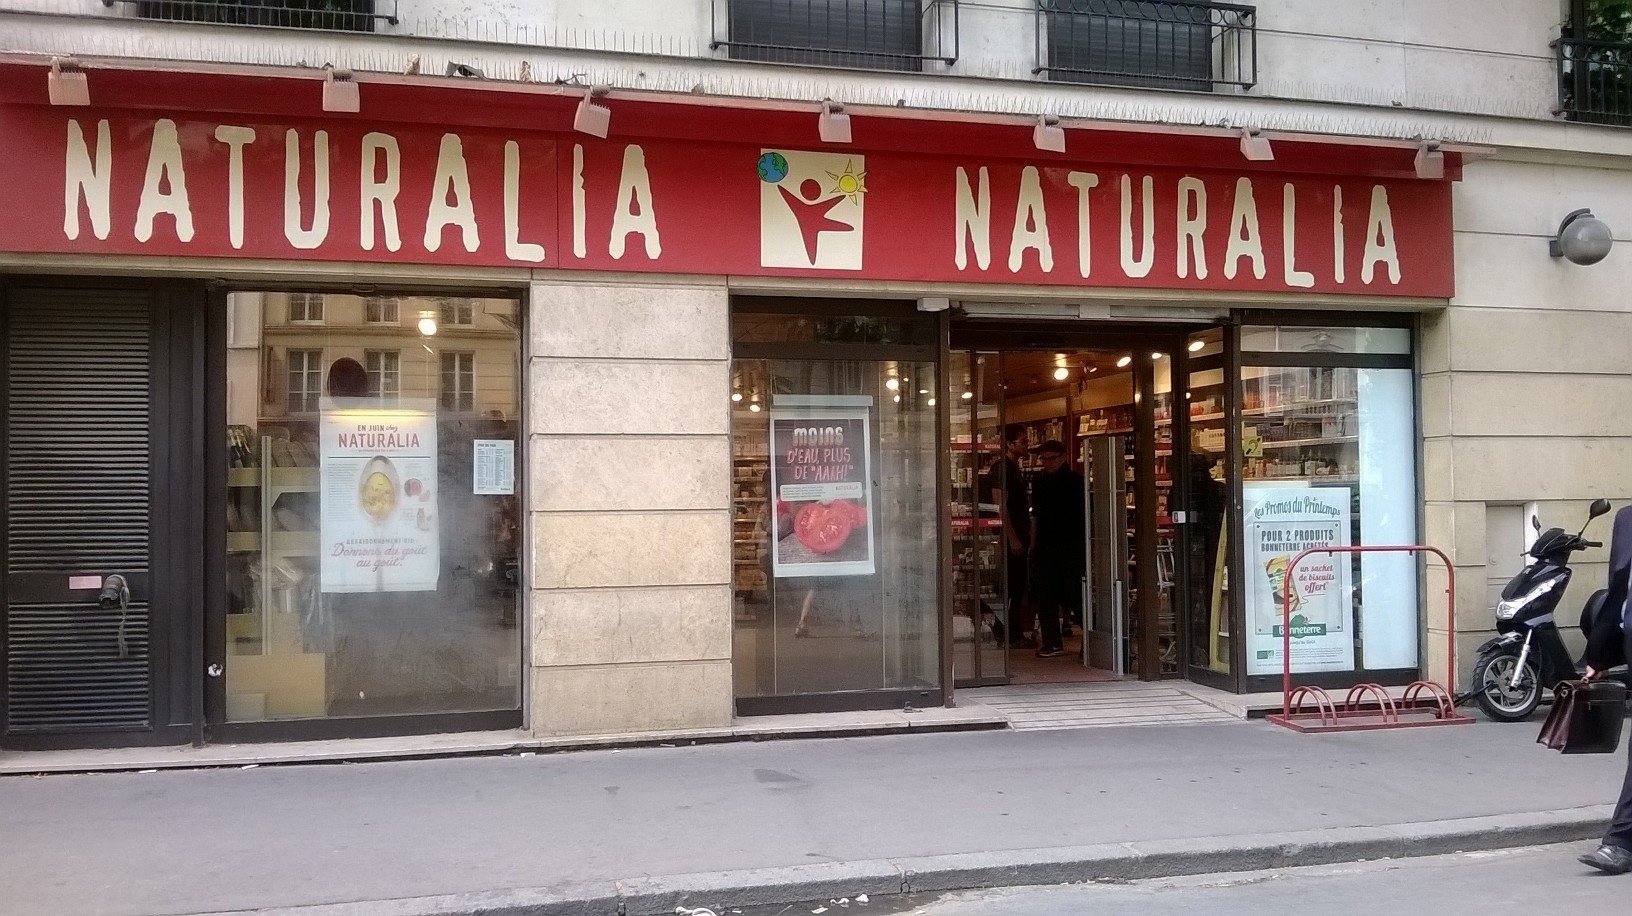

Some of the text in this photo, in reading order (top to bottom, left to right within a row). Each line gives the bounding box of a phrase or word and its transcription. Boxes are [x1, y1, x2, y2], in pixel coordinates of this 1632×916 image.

[63, 118, 662, 262] NATURALIA
[954, 165, 1402, 288] NATURALIA
[357, 424, 367, 432] EN
[369, 424, 385, 432] JUIN
[338, 433, 420, 449] NATURALIA
[823, 447, 851, 463] PLUS
[794, 465, 808, 480] DE
[1292, 496, 1303, 514] du
[1304, 495, 1341, 519] Printemps
[1261, 529, 1334, 541] POUR 2 PRODUITS
[1261, 542, 1301, 552] BONNETERRE
[356, 560, 372, 568] au
[1310, 564, 1333, 572] sachet
[1308, 572, 1335, 581] biscuits
[1278, 625, 1322, 635] Bnneterre
